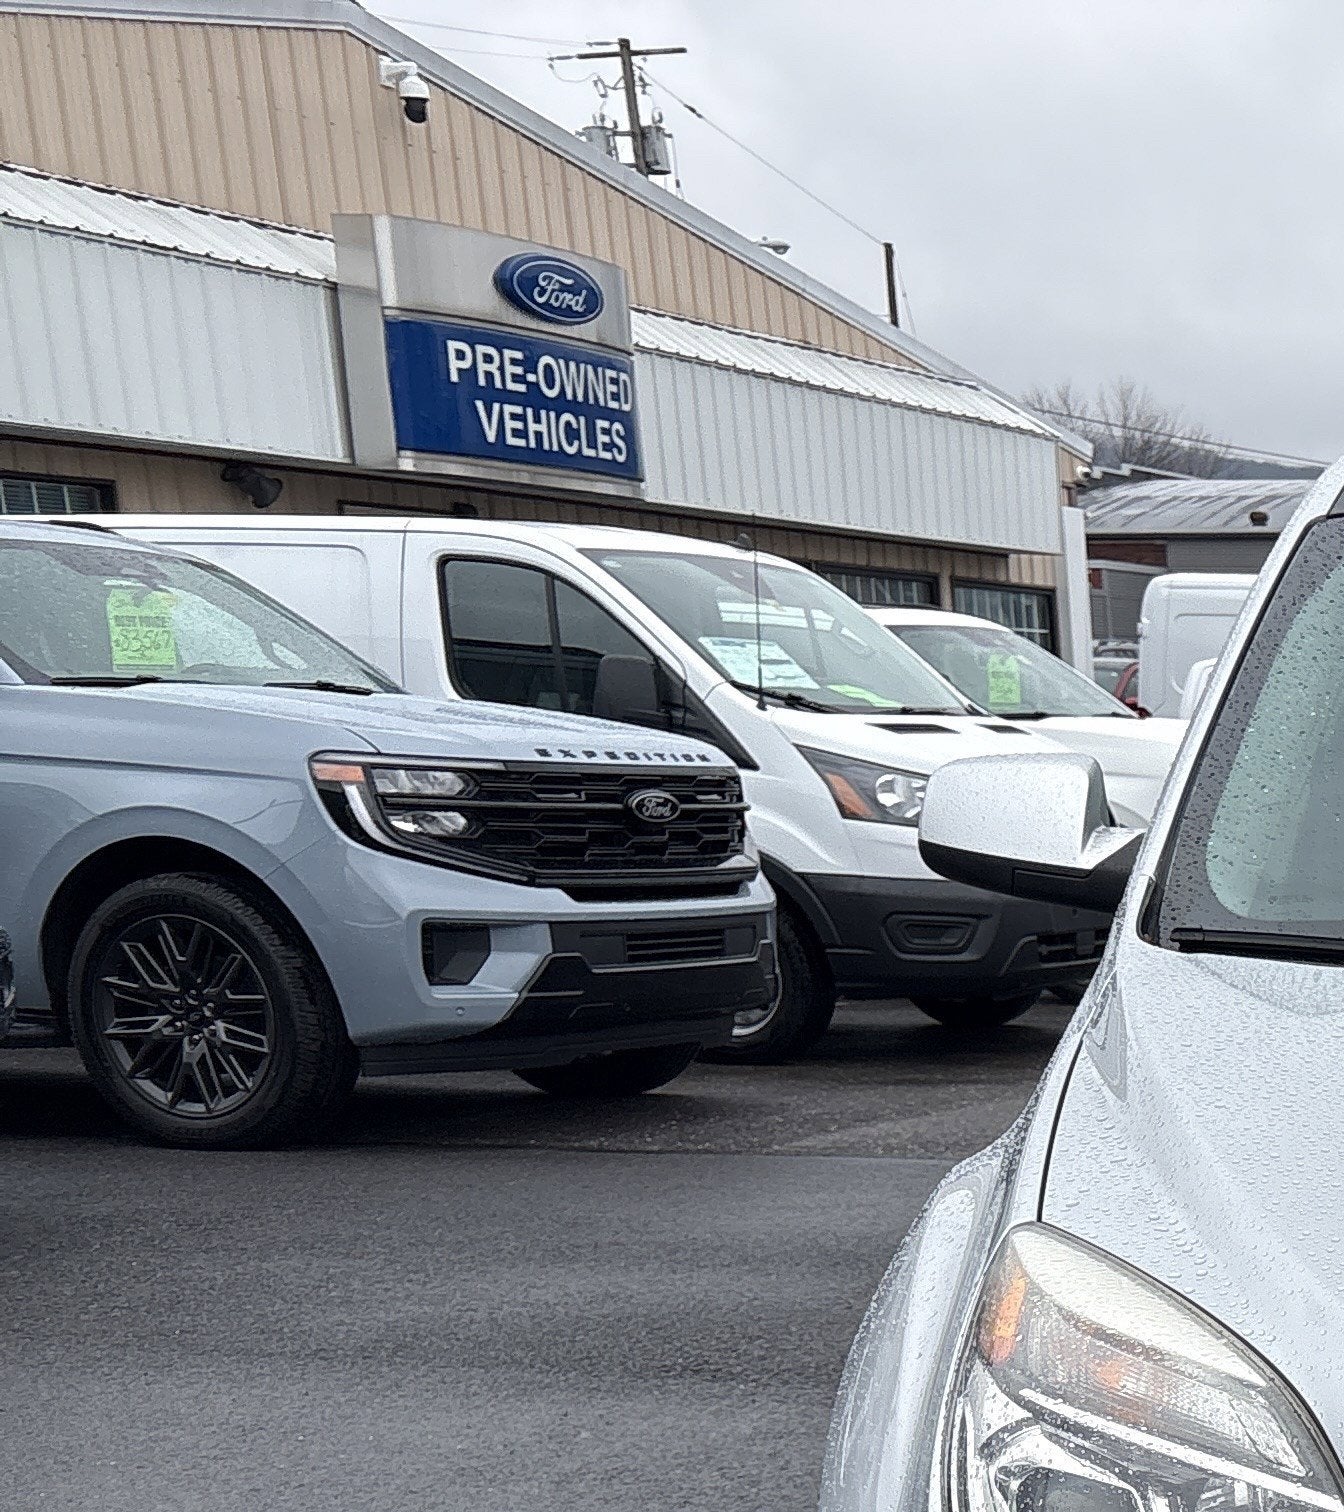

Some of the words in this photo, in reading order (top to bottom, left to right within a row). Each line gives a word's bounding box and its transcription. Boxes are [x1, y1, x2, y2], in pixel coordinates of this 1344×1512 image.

[533, 271, 587, 313] Ford
[446, 339, 633, 413] PRE-OWNED
[474, 399, 628, 464] VEHICLES
[641, 796, 673, 818] Ford
